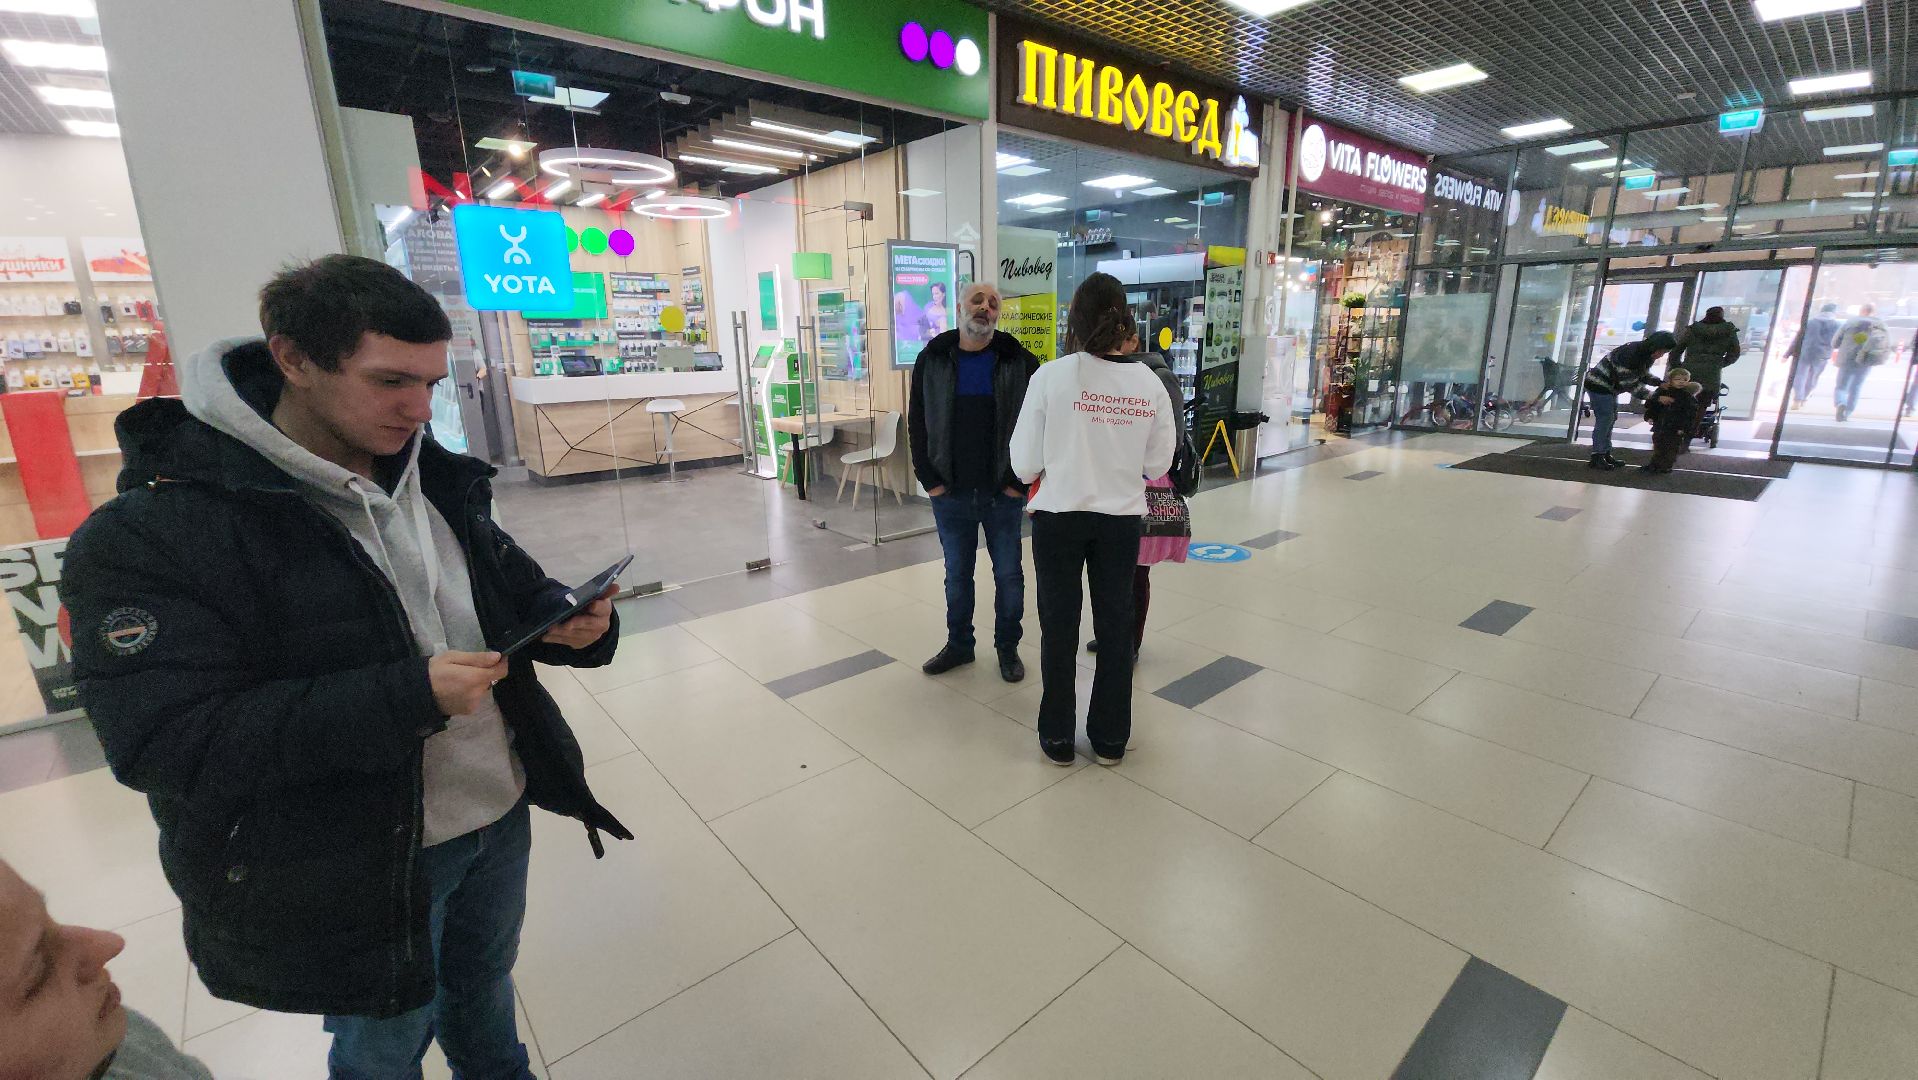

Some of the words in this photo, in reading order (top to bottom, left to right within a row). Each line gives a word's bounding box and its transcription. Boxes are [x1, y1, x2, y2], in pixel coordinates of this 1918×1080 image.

[1020, 40, 1222, 159] ПИВОВЕД
[1330, 140, 1362, 176] VITA
[1366, 152, 1428, 194] FLOWERS
[484, 273, 556, 294] YOTA
[1002, 312, 1052, 321] КЛАССИЧЕСКИЕ
[1011, 326, 1051, 335] КРАФТОВЫЕ
[1034, 340, 1044, 349] СО
[1081, 390, 1150, 407] ВОЛОНТЕРЫ
[1073, 401, 1156, 419] ПОДМОСКОВЬЯ
[1091, 416, 1105, 424] МЫ
[1106, 417, 1133, 426] РЯДОМ
[1147, 505, 1182, 516] ASHION
